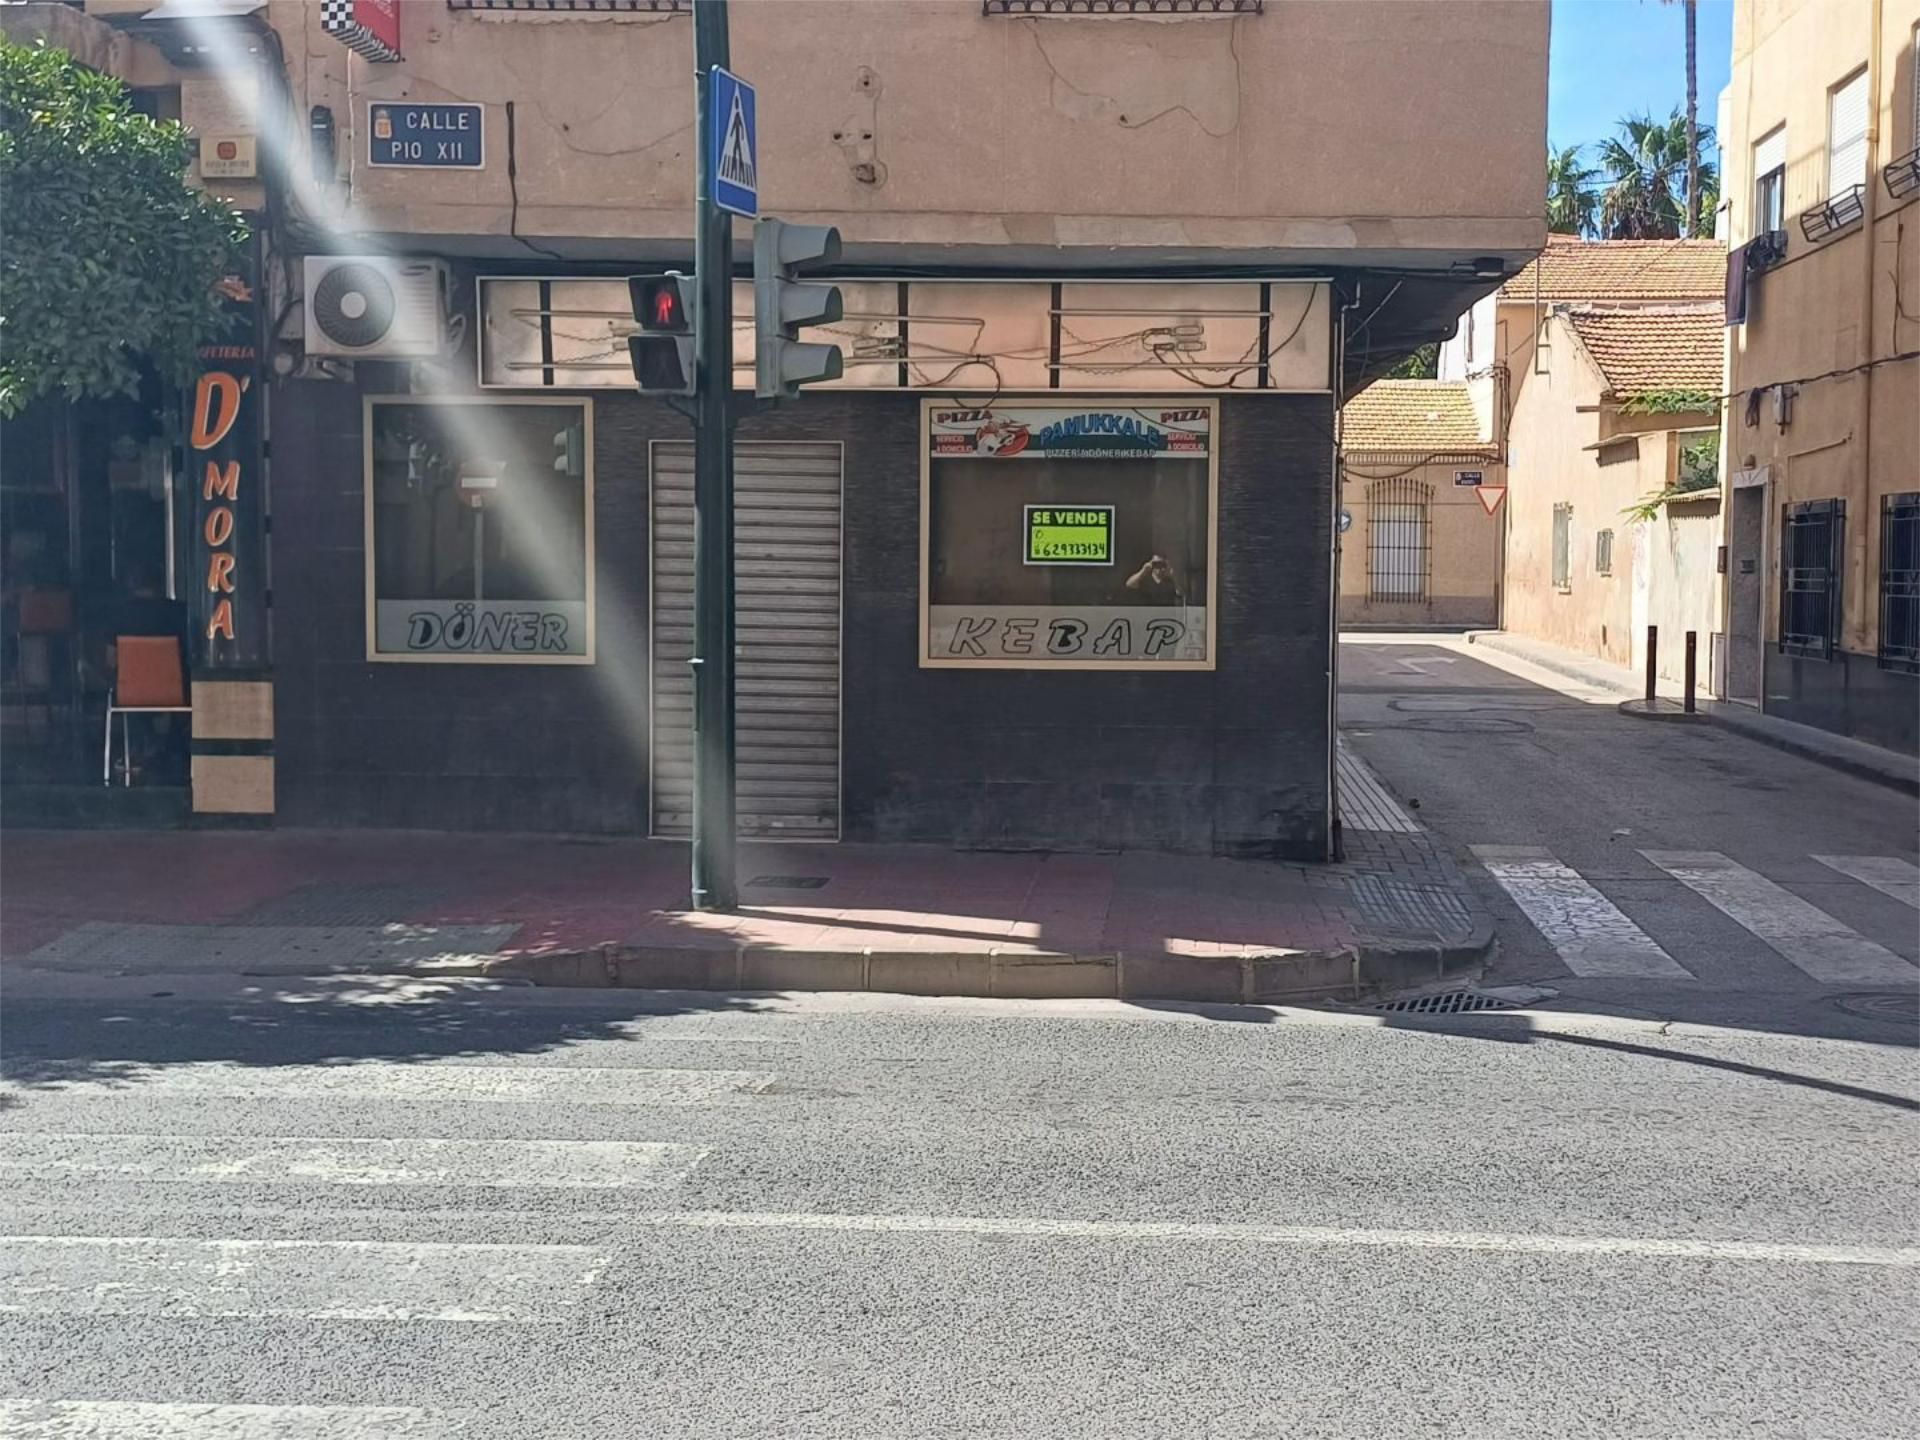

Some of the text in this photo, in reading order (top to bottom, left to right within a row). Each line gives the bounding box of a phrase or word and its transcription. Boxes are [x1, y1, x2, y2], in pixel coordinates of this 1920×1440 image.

[406, 111, 470, 130] CALLE
[391, 141, 463, 160] PIO XII
[197, 346, 255, 359] FETERIA
[191, 371, 251, 449] D'
[936, 410, 993, 423] PIZZA
[1160, 409, 1209, 423] PIZZA
[1039, 413, 1161, 447] PAMUKKALE
[1032, 511, 1107, 525] SE VENDE
[203, 461, 241, 640] MORA
[408, 602, 568, 650] DÖNER
[949, 617, 1185, 656] KEBAP
